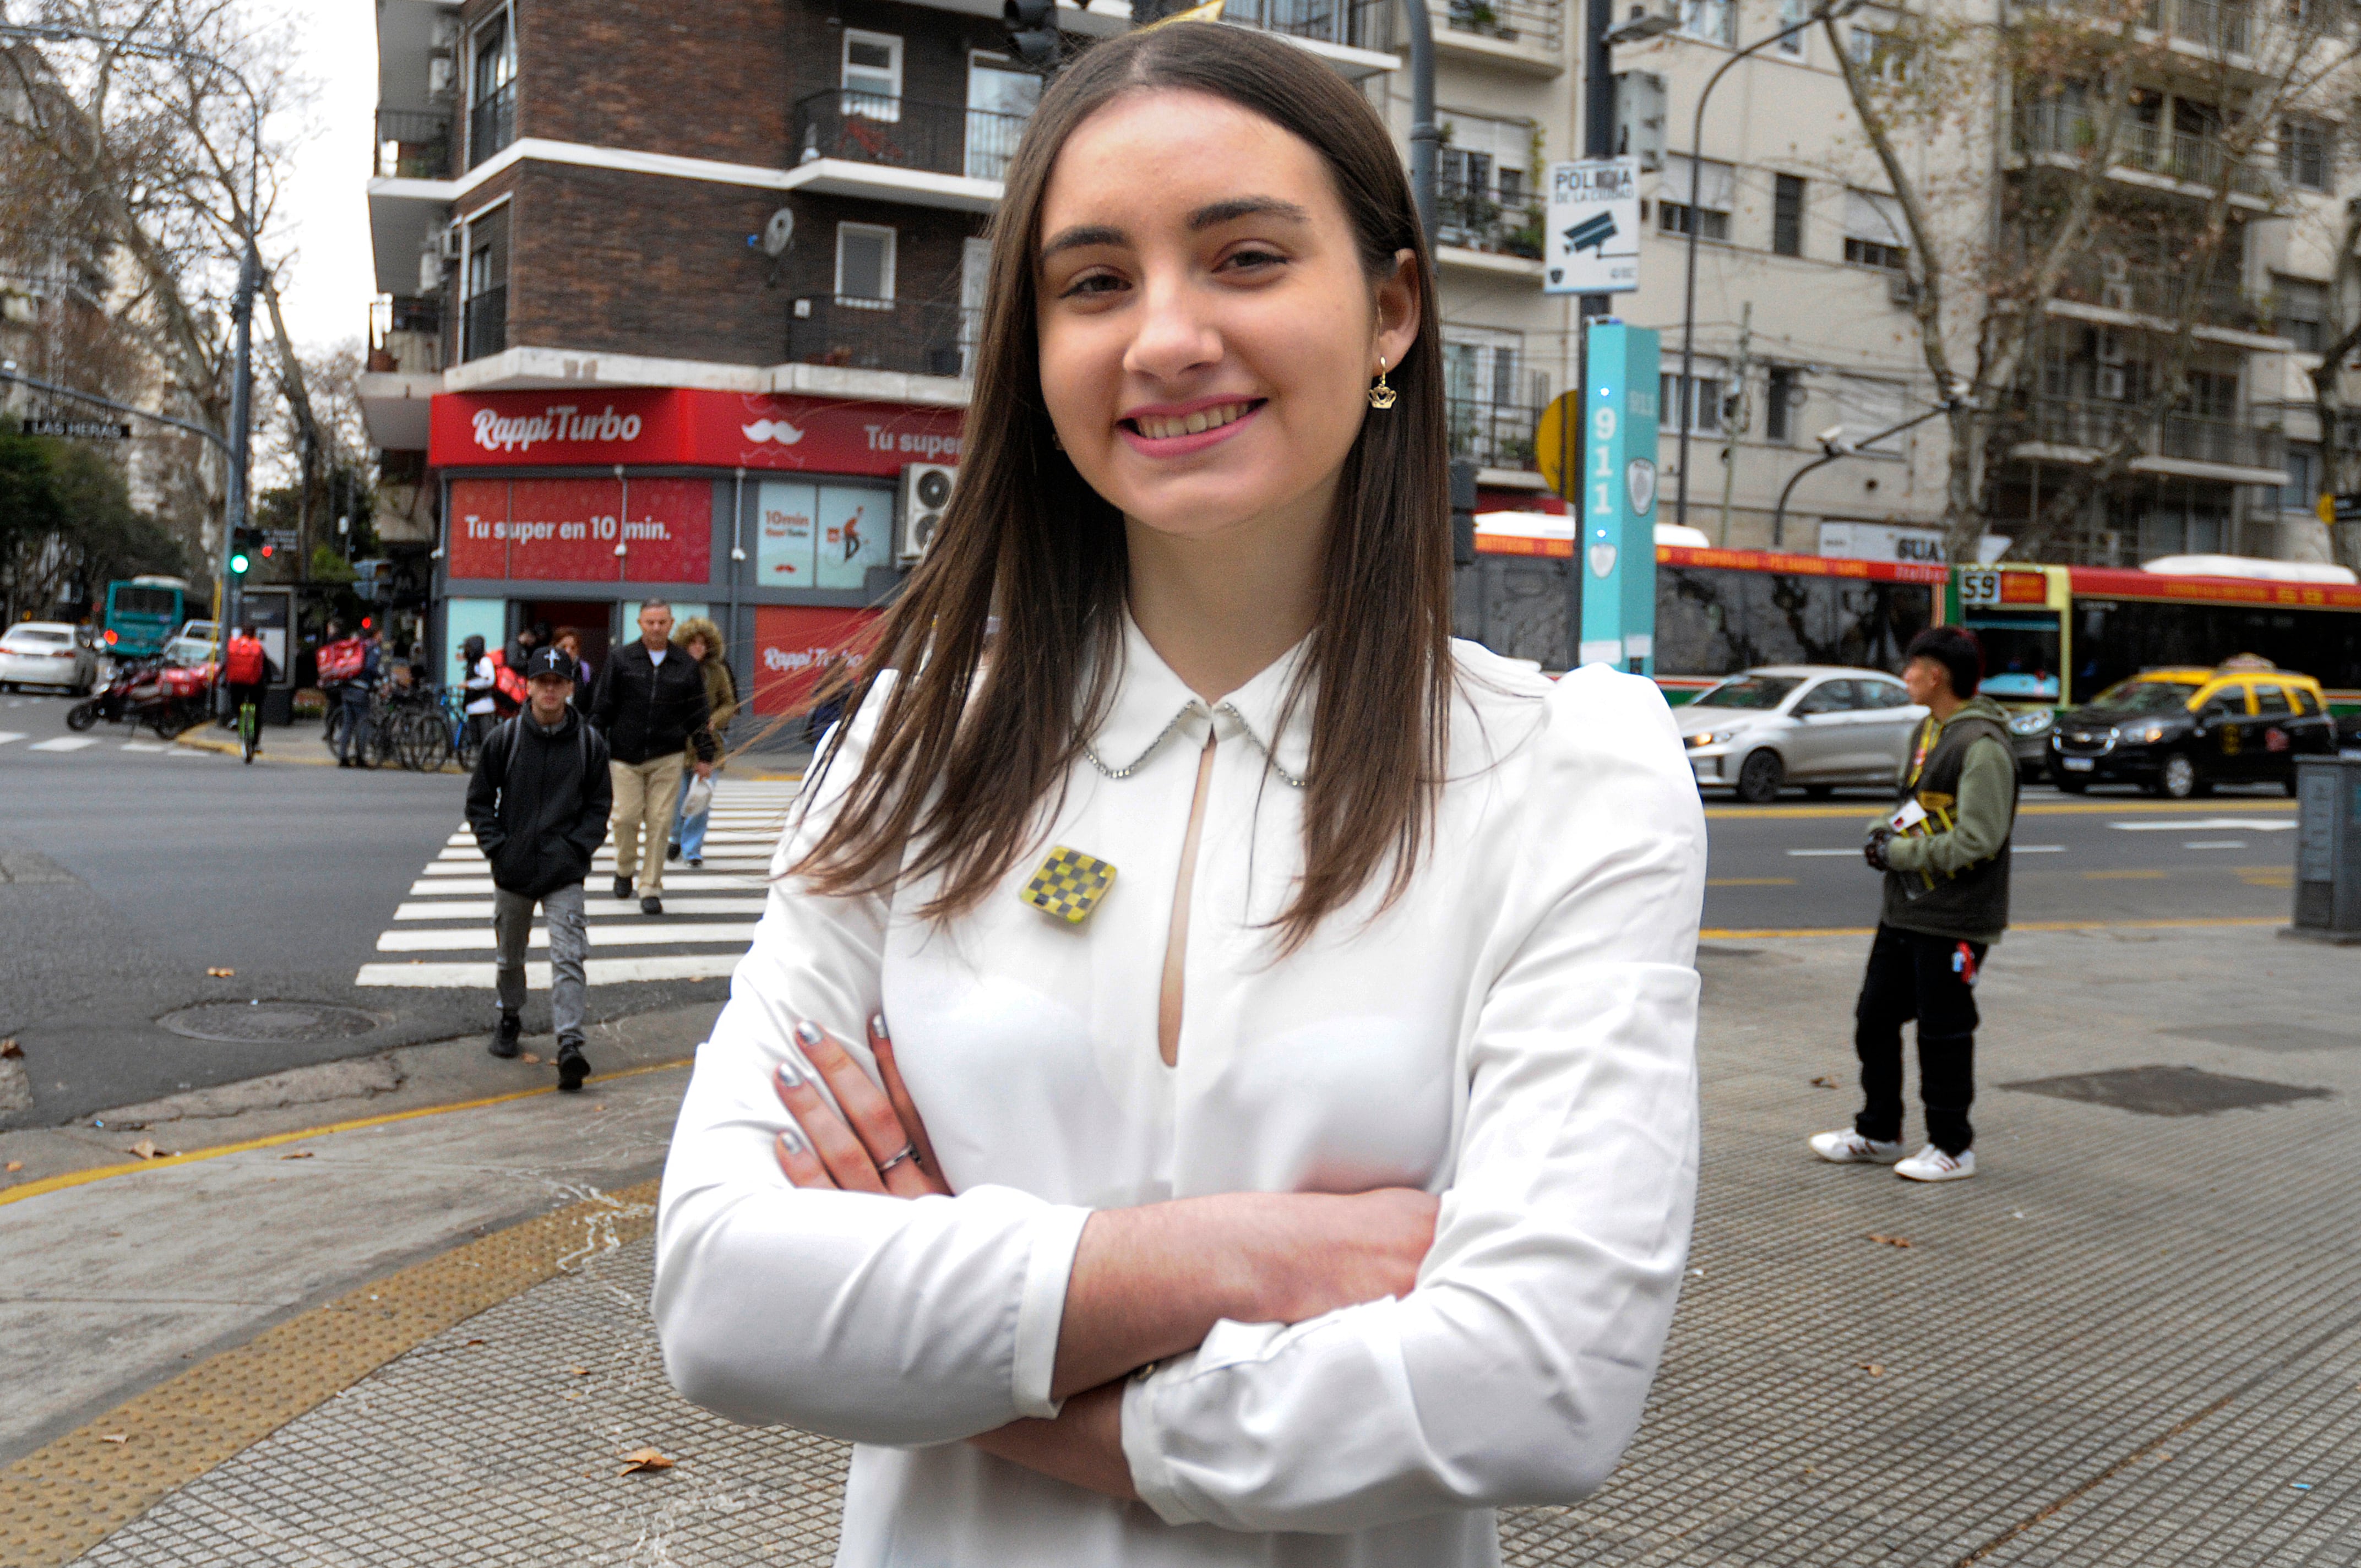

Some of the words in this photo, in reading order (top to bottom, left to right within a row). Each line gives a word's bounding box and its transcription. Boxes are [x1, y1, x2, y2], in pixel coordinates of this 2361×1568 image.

[863, 424, 894, 451] Tu
[465, 515, 490, 539] Tu
[494, 521, 557, 545] super
[559, 522, 586, 540] en
[590, 515, 617, 540] 10
[622, 515, 672, 541] min.
[1963, 575, 1995, 598] 59
